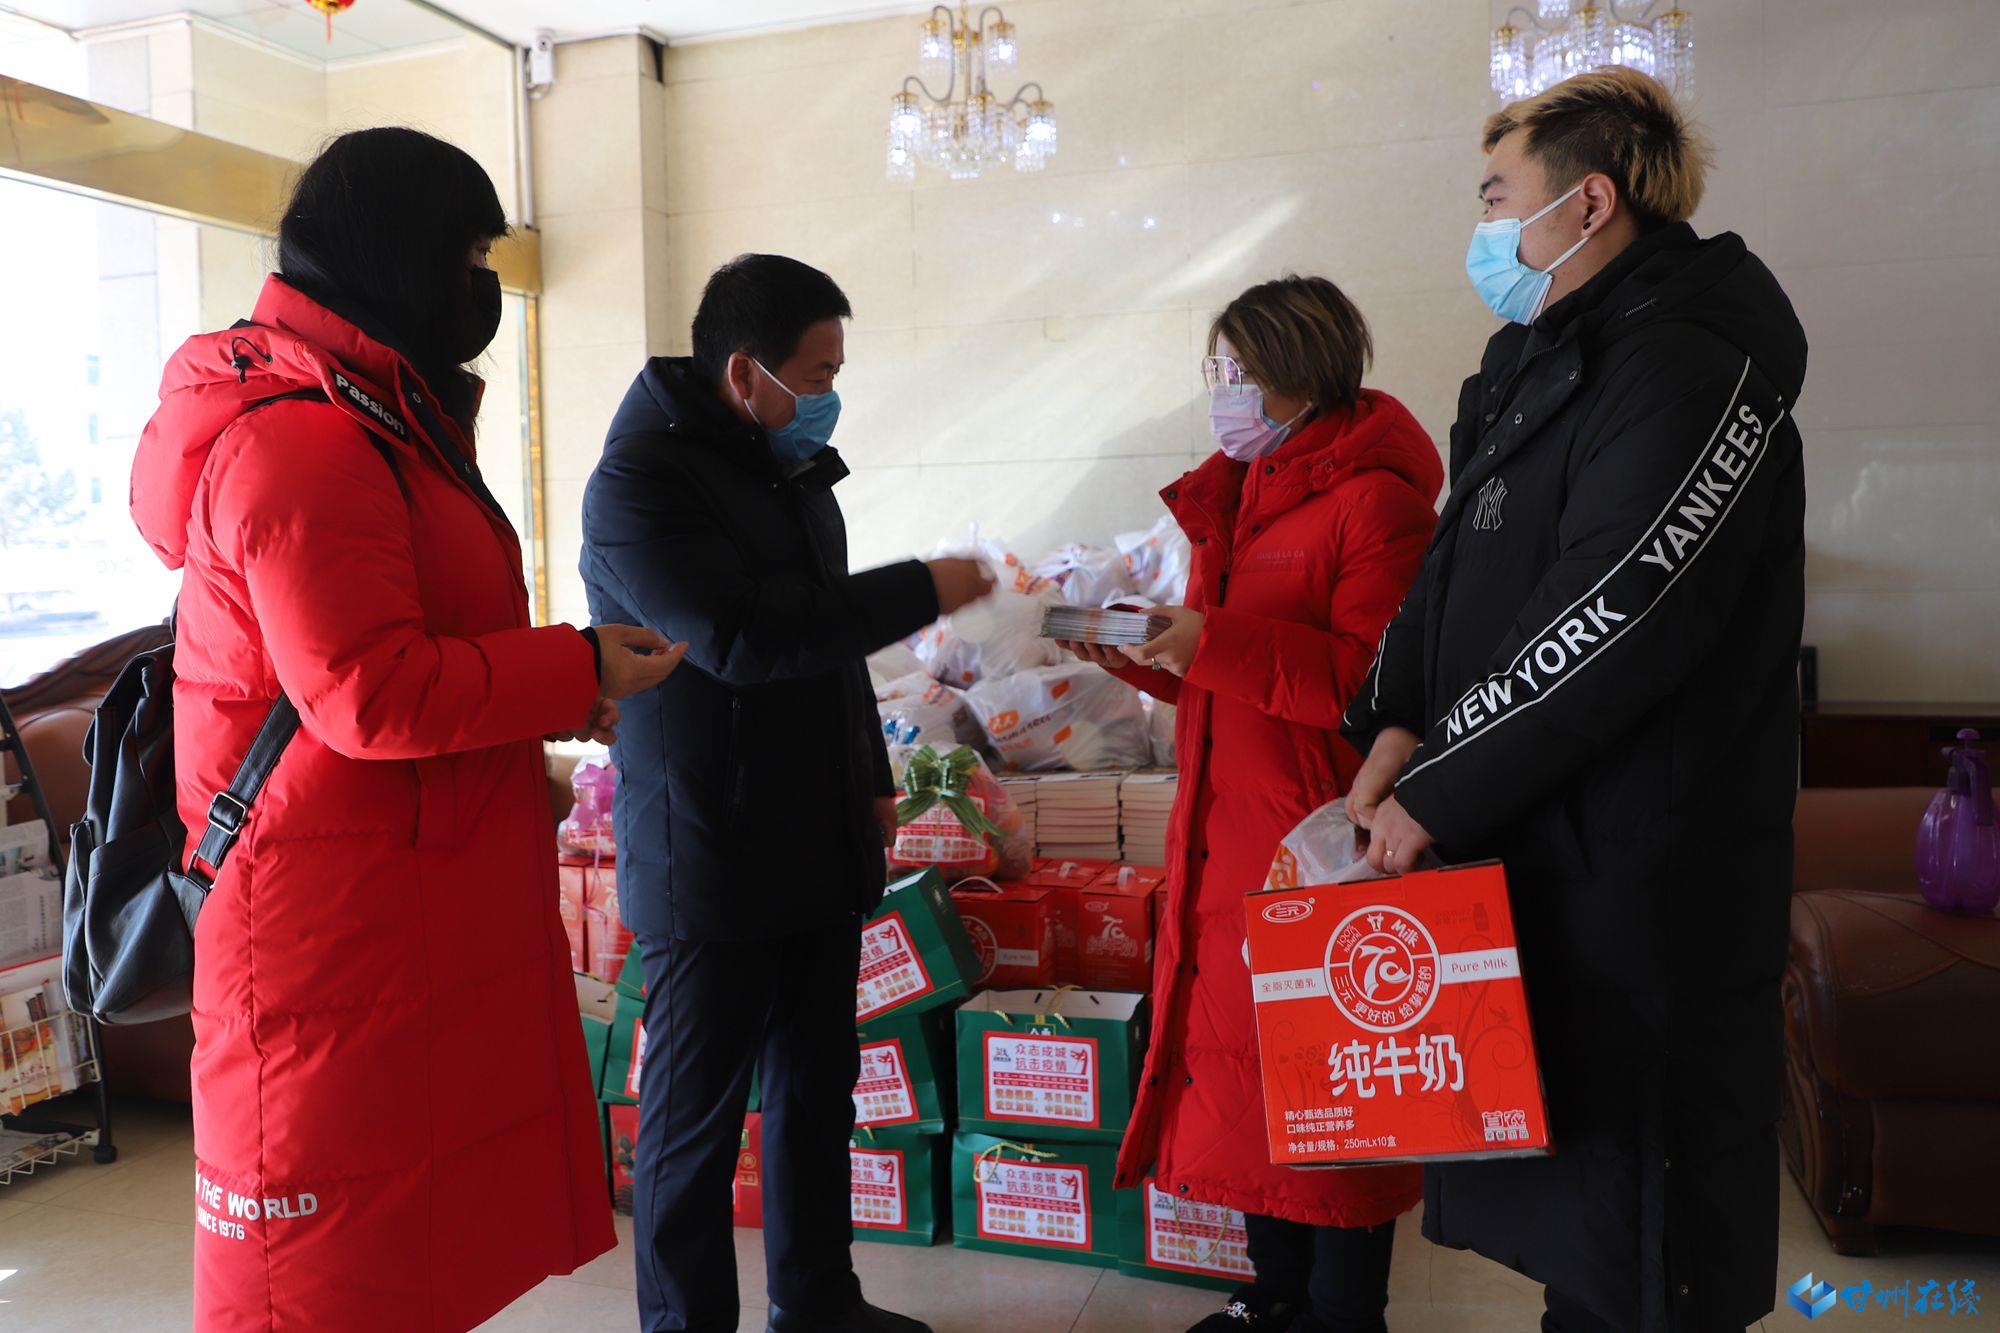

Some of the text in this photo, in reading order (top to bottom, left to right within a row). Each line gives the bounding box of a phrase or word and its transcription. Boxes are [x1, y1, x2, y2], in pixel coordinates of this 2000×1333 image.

[335, 373, 405, 436] Passion
[1446, 404, 1765, 743] NEW YORK YANKEES
[1336, 922, 1356, 947] 100%
[1391, 918, 1419, 948] Milk
[1451, 957, 1508, 974] Pure Milk
[1262, 977, 1316, 993] 全脂灭菌乳
[1334, 974, 1356, 1004] 三元
[1016, 1043, 1067, 1058] 众志成城
[1016, 1057, 1067, 1073] 抗击疫情
[1328, 1033, 1465, 1098] 纯牛奶
[1284, 1106, 1354, 1121] 精心甄选品质好
[1286, 1120, 1355, 1135] 口味纯正营养多
[201, 1177, 223, 1210] THE
[227, 1192, 318, 1221] WORLD
[197, 1205, 246, 1240] SINCE 1976
